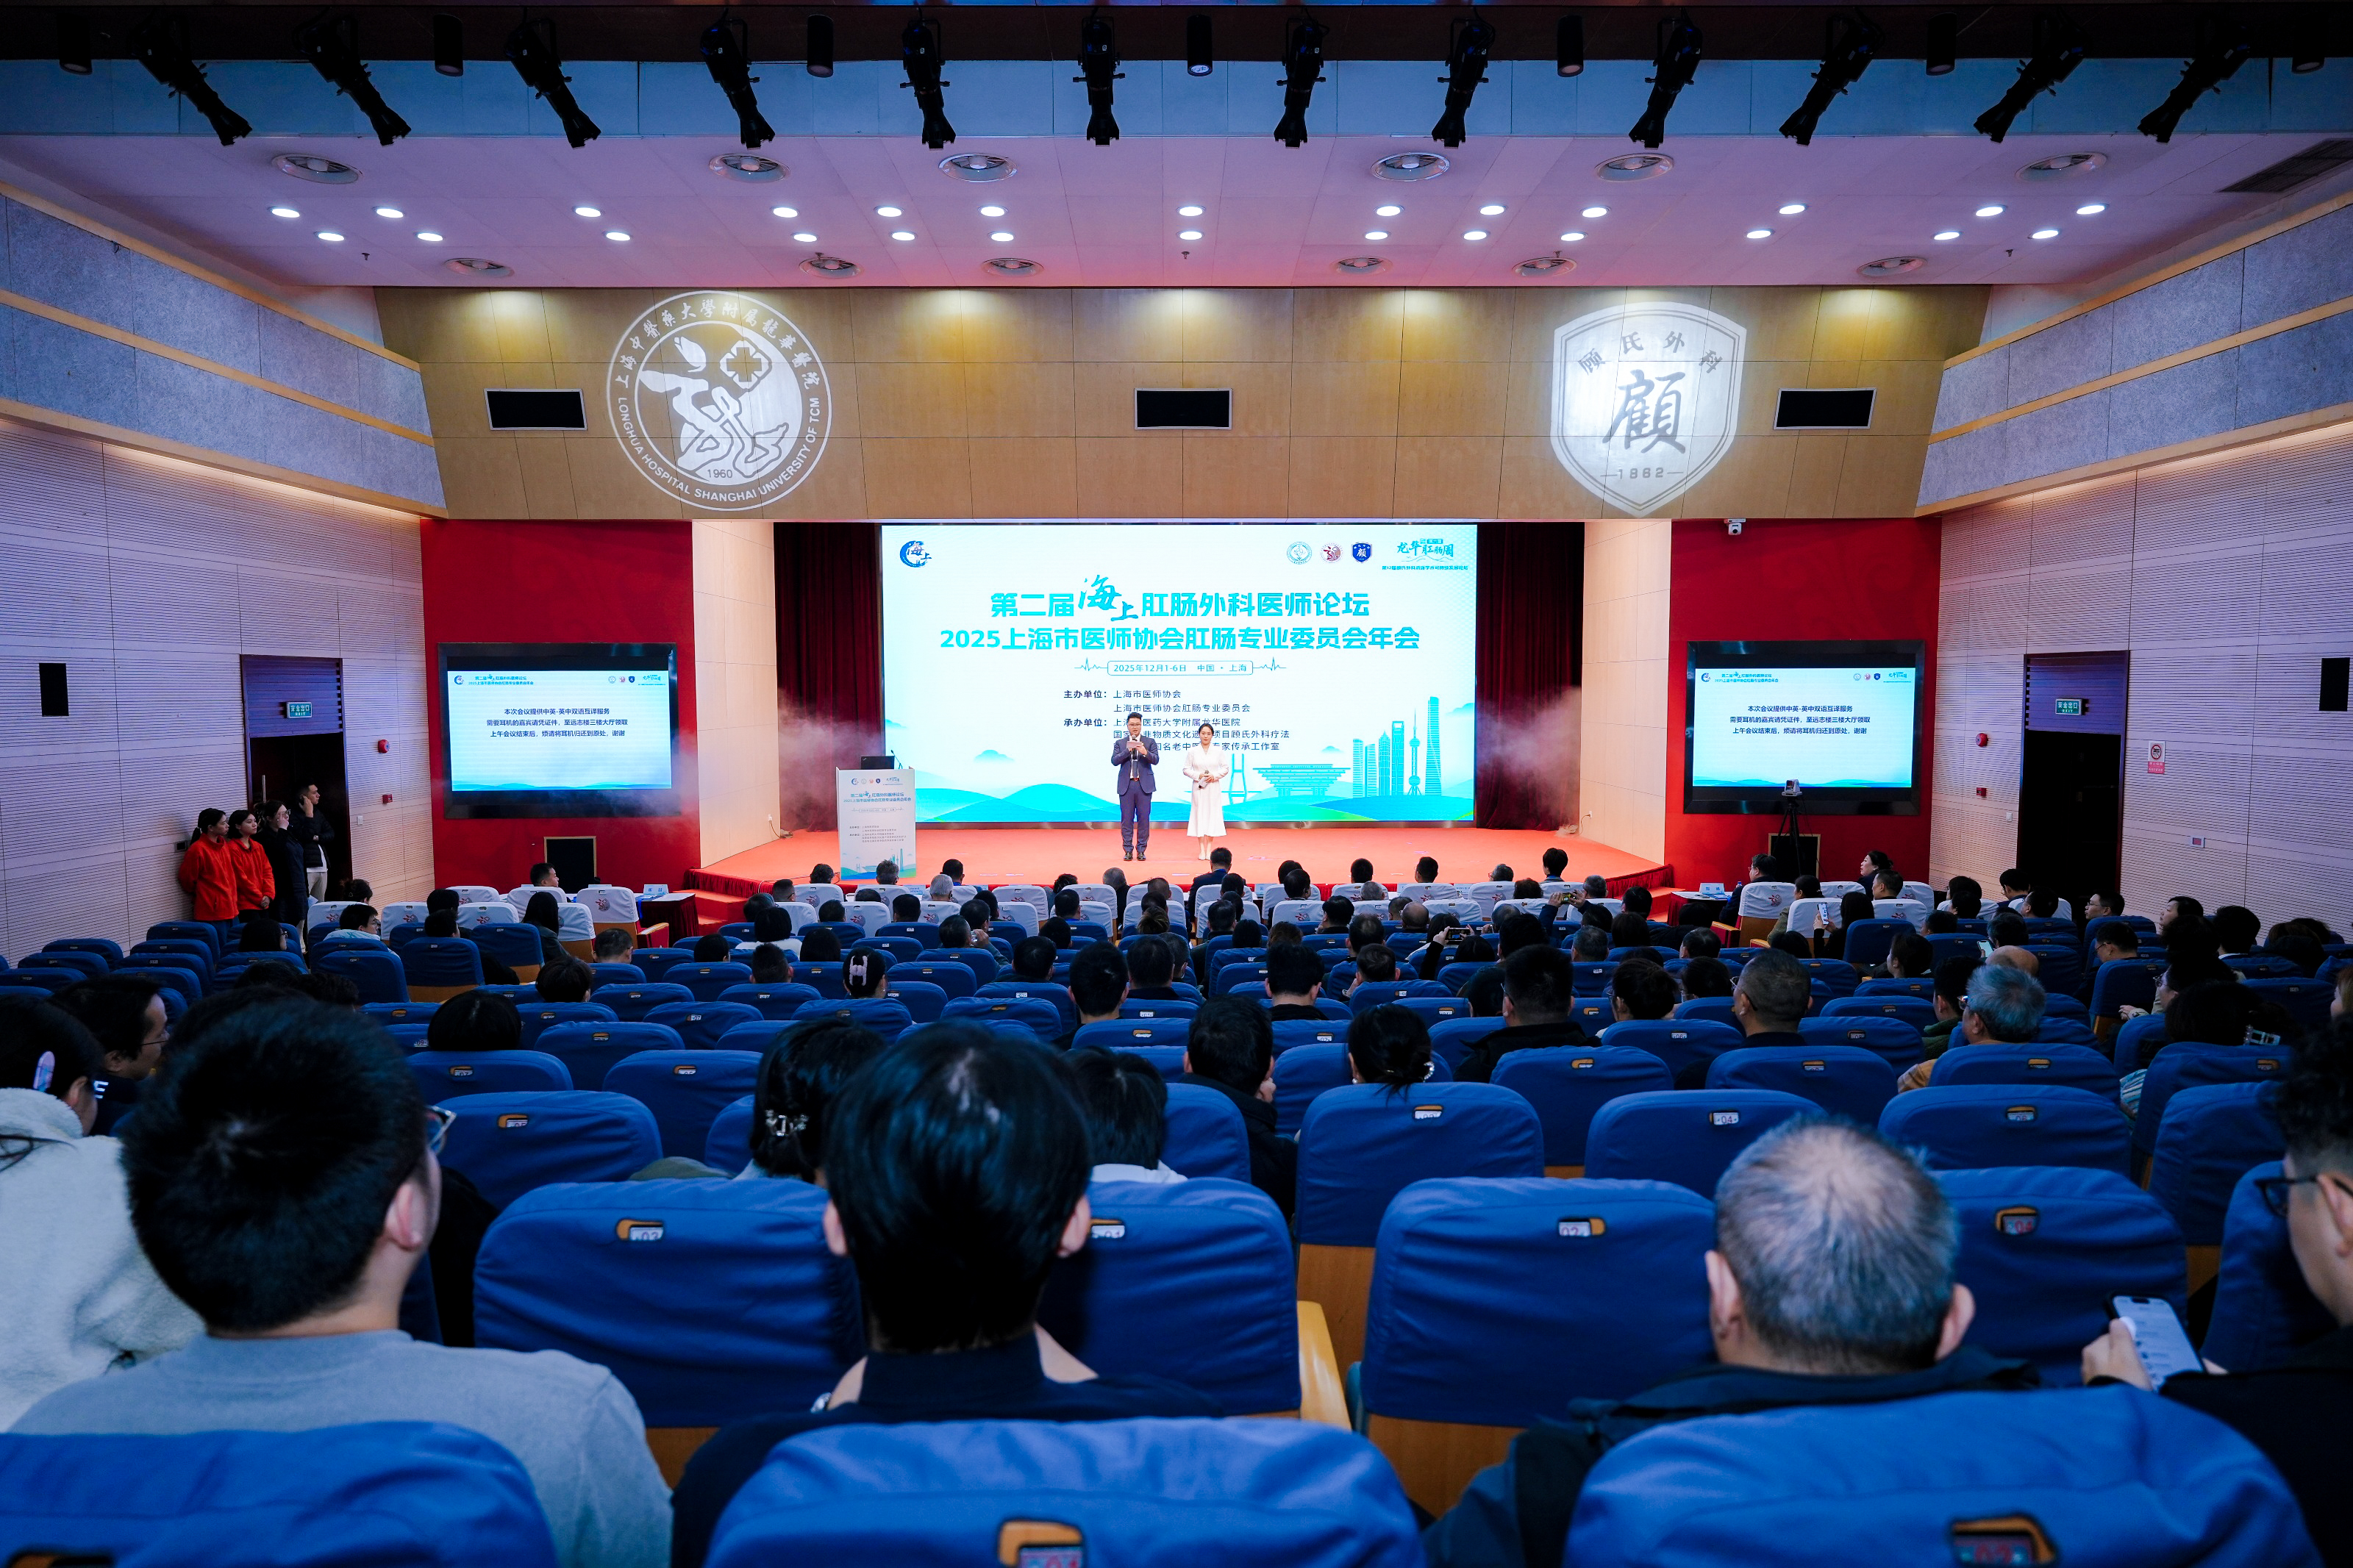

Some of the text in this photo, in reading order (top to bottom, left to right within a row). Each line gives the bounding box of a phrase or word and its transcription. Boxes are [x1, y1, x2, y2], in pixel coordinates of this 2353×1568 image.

[618, 397, 821, 502] LONGHUA HOSPITAL SHANGHAI UNIVERSITY OF TCM
[707, 469, 733, 479] 1960
[990, 574, 1370, 622] 第二届海上肛肠外科医师论坛
[940, 627, 1420, 650] 2025上海市医师协会肛肠专业委员会年会
[1113, 664, 1187, 673] 2025年12月1-6日
[1113, 690, 1182, 698] 上海市医师协会
[1113, 704, 1251, 712] 上海市医师协会肛肠专业委员会
[1720, 1114, 1732, 1124] 04
